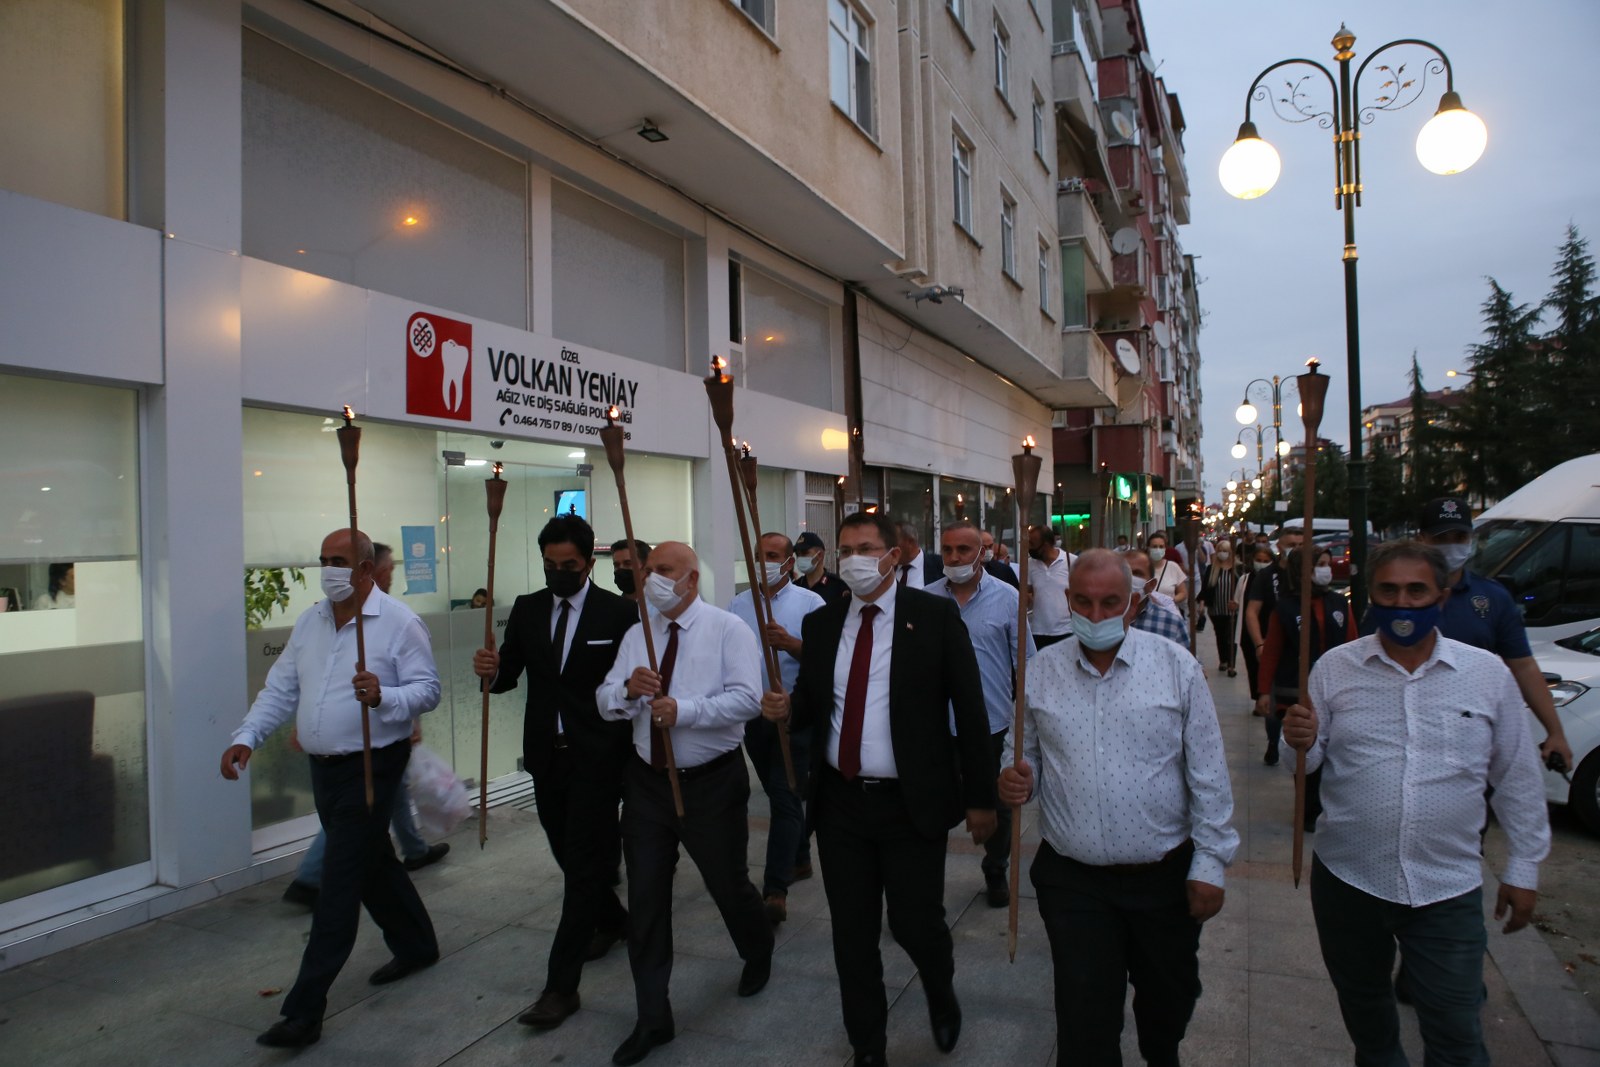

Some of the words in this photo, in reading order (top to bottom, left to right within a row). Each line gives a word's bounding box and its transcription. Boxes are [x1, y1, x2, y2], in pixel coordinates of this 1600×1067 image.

[561, 346, 580, 364] ÖZEL
[487, 347, 572, 397] VOLKAN
[577, 368, 638, 409] YENİAY
[496, 388, 520, 405] AĞIZ
[522, 393, 535, 407] VE
[537, 395, 553, 413] DİŞ
[539, 418, 552, 429] 715
[553, 420, 561, 430] 17
[561, 422, 572, 432] 89
[578, 425, 584, 434] 0
[585, 425, 600, 436] 507
